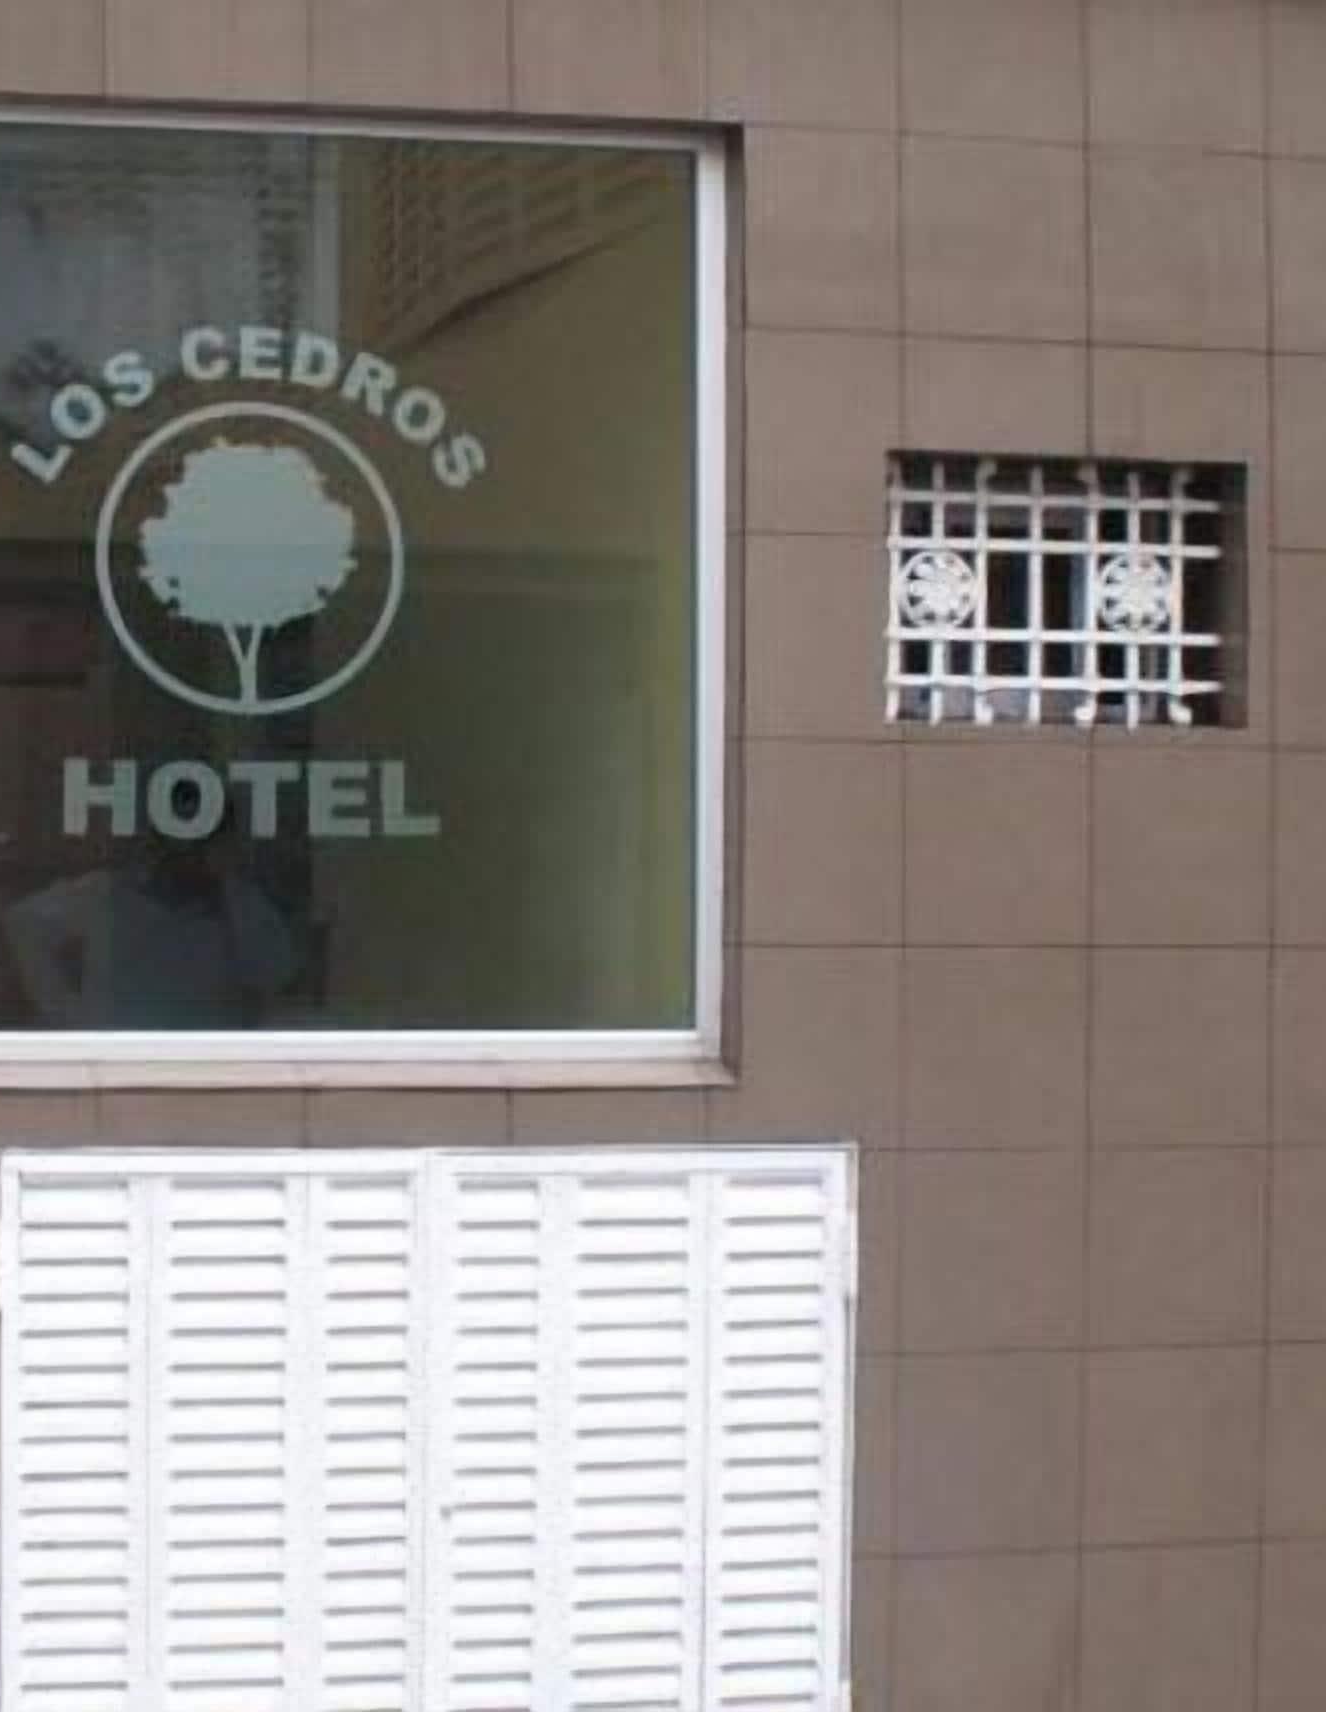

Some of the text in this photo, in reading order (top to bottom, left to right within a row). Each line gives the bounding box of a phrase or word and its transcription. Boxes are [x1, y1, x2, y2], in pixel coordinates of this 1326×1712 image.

[11, 326, 486, 488] LOS CEDROS
[62, 757, 441, 840] HOTEL
